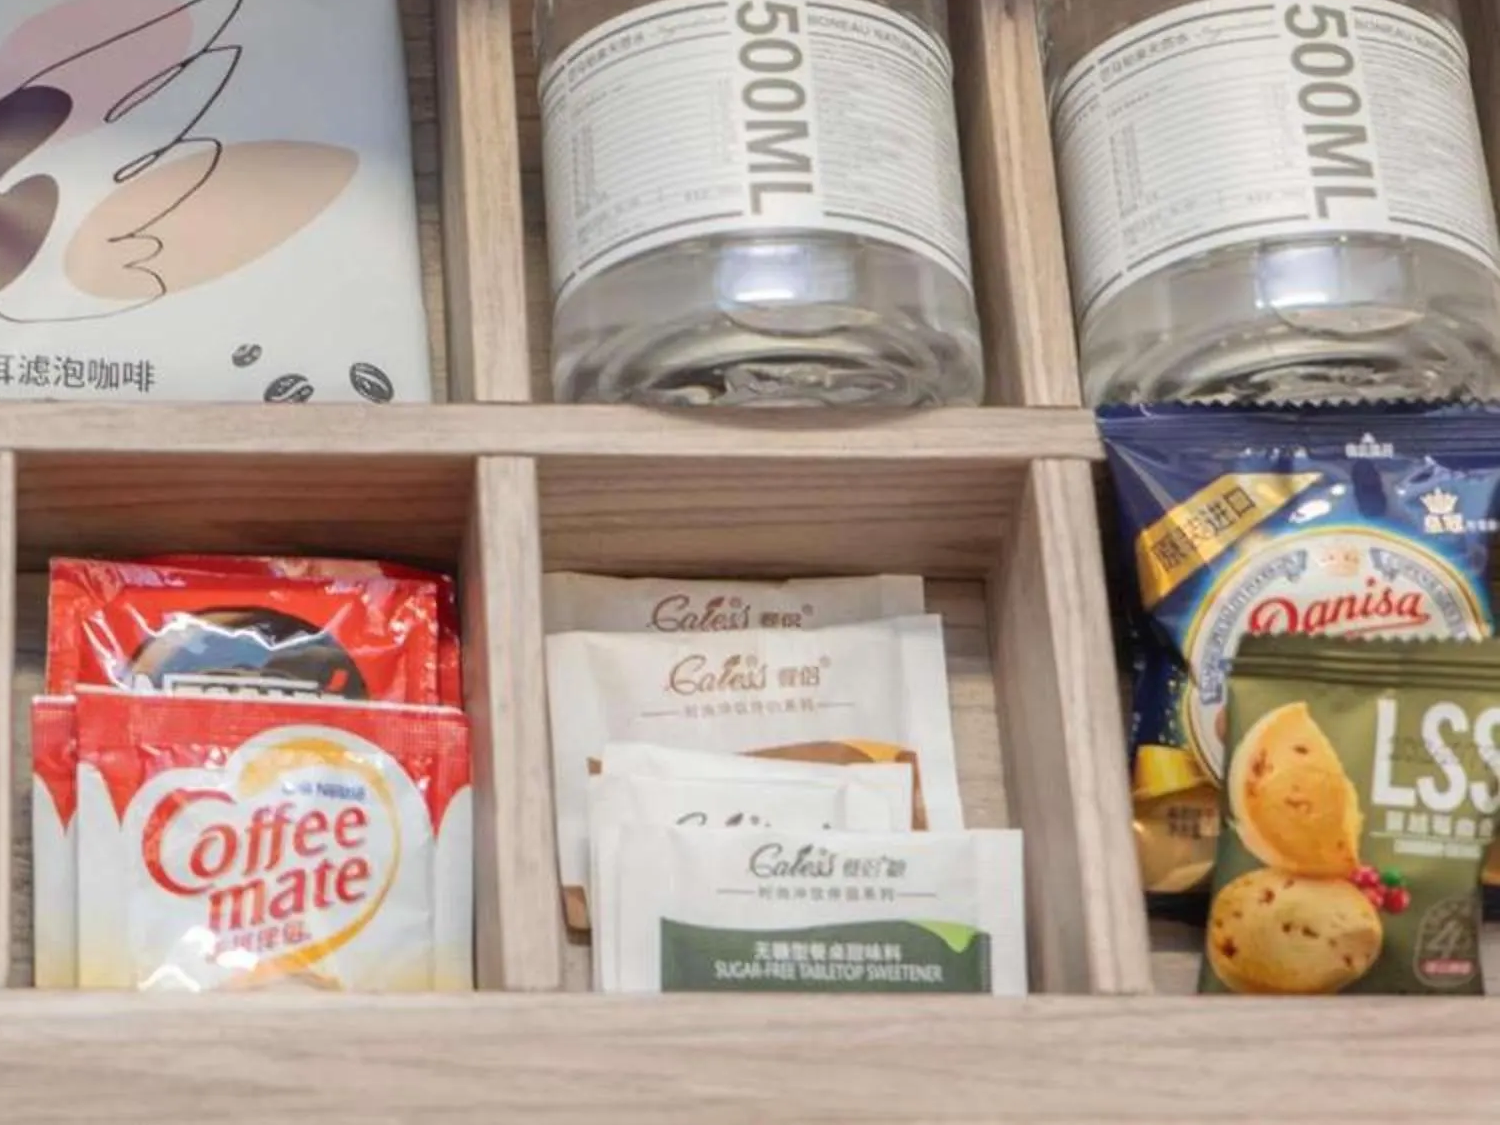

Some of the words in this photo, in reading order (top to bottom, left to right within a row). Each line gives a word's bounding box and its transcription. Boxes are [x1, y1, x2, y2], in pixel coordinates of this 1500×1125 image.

[735, 0, 814, 216] 500ML
[1284, 3, 1377, 219] 500ML
[1247, 576, 1431, 636] Danisa
[141, 788, 369, 897] Coffee
[206, 855, 372, 931] mate
[714, 960, 798, 981] SUGAR-FREE
[799, 962, 865, 982] TABLETOP
[866, 963, 944, 983] SWEETENER
